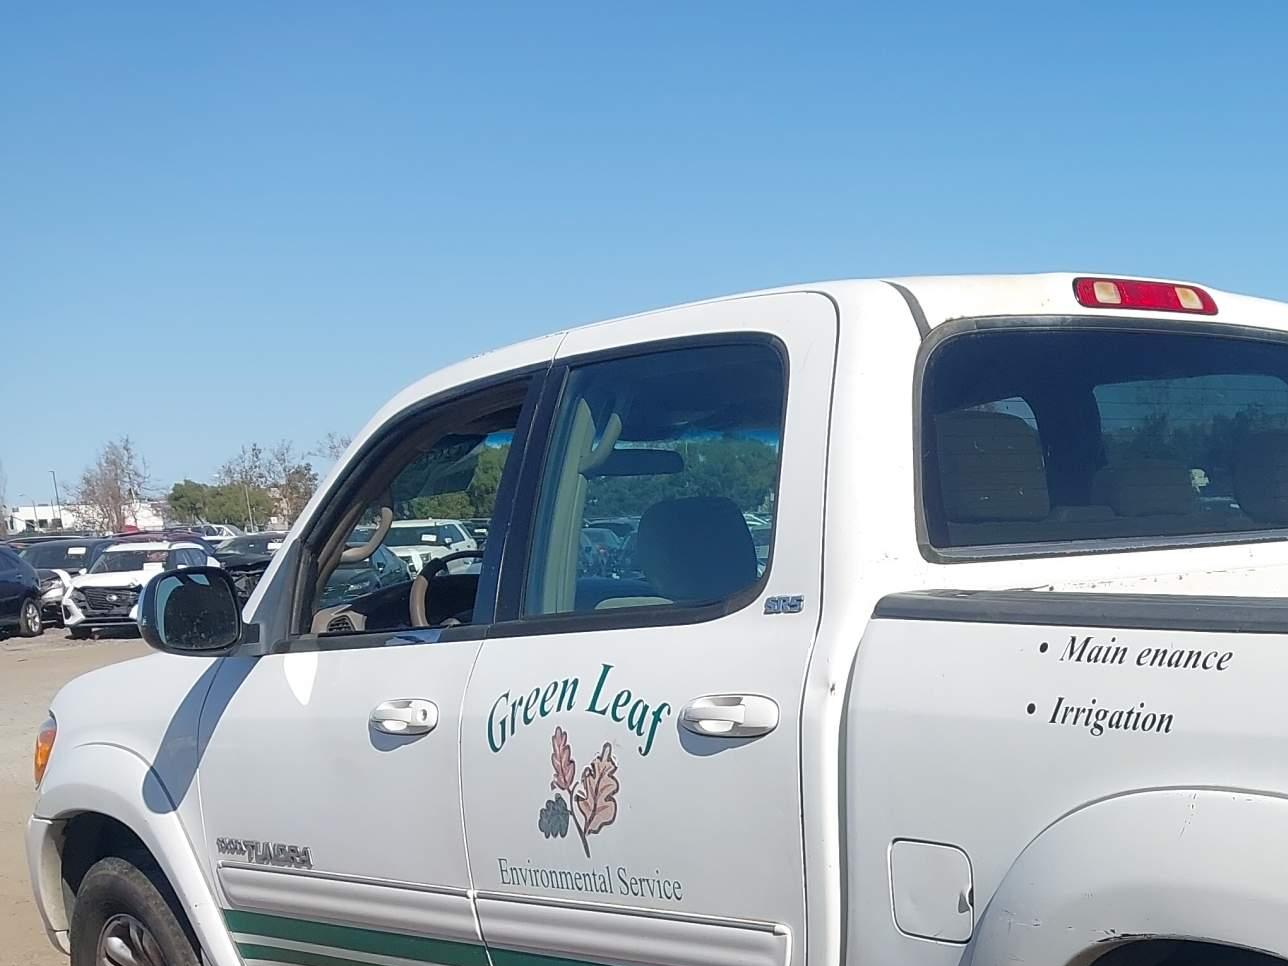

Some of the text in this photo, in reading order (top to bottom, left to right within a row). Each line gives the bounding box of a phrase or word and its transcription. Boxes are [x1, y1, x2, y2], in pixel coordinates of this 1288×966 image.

[487, 663, 671, 757] Green Leaf
[1048, 697, 1175, 737] Irrigation
[498, 858, 683, 901] Environmental Service
